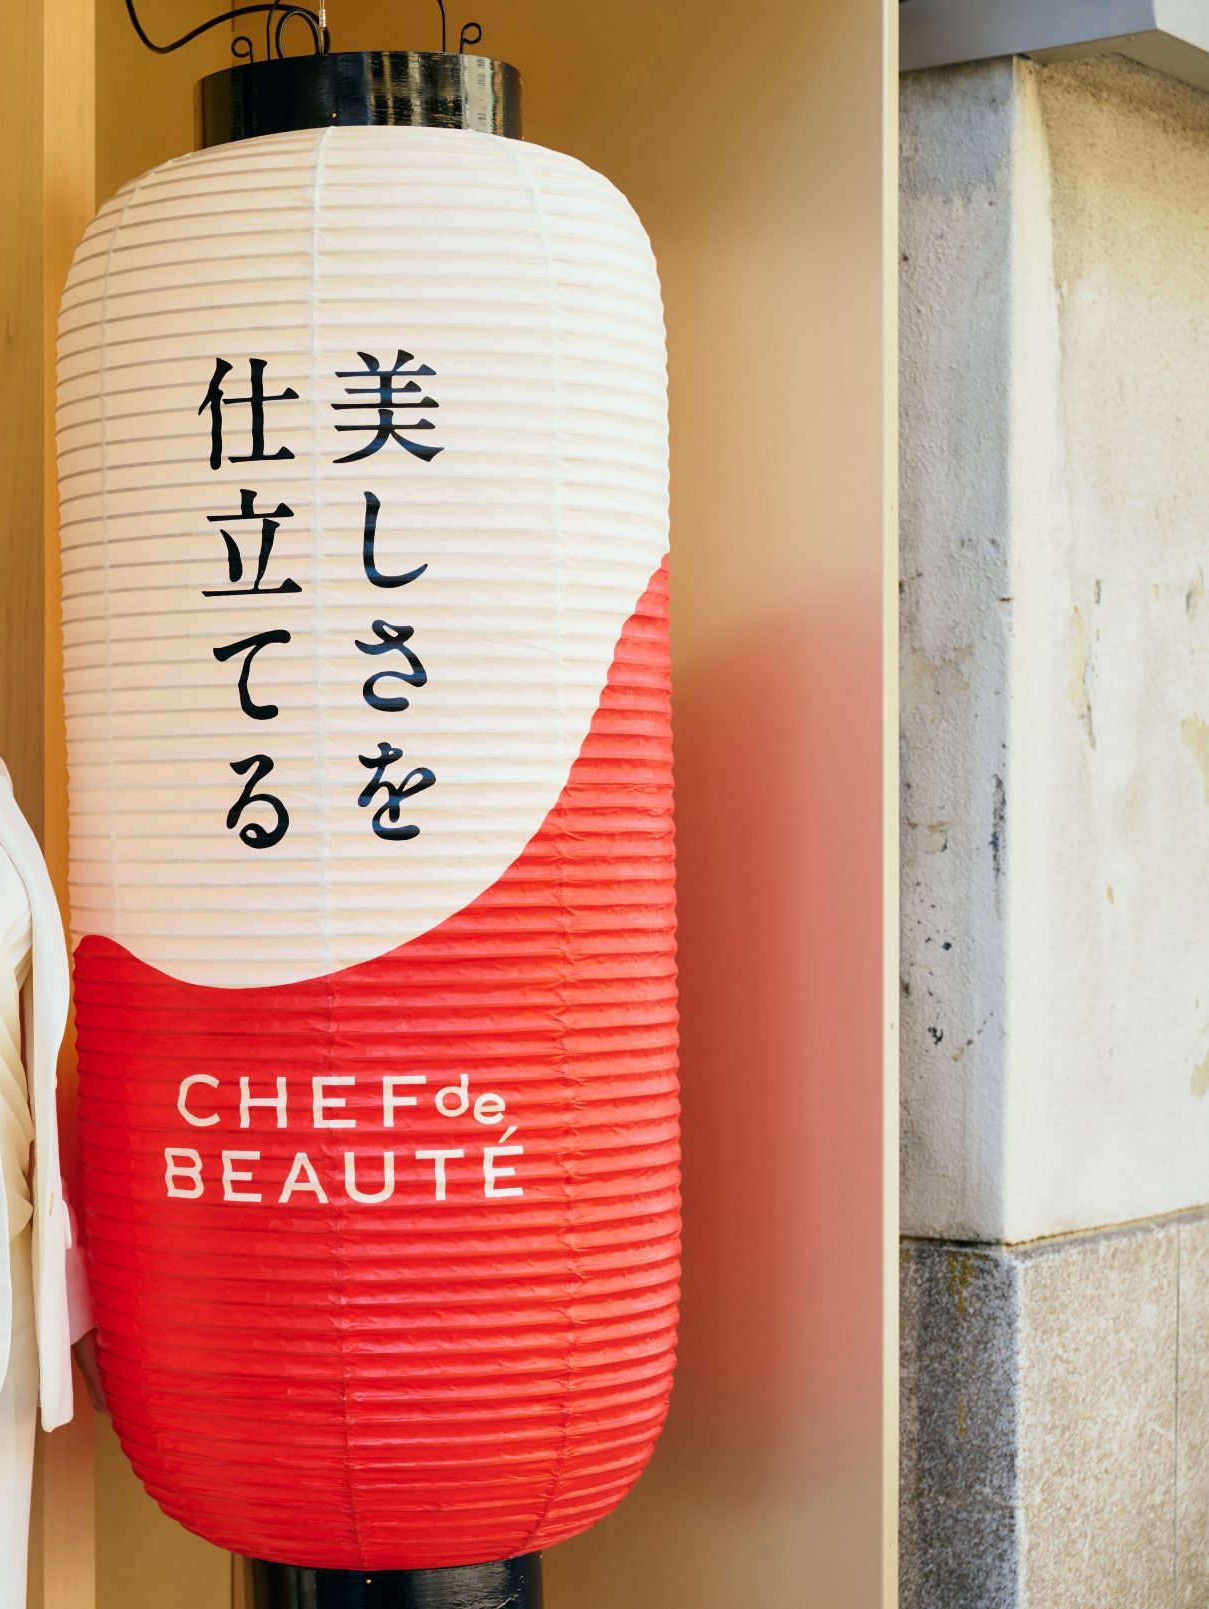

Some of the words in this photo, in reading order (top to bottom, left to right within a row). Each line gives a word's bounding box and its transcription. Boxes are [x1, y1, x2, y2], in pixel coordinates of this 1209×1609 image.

[197, 357, 303, 850] 仕立てる
[330, 349, 445, 841] 美しさを
[164, 1125, 525, 1204] BEAUTÉ
[177, 1073, 427, 1128] CHEF
[434, 1073, 507, 1125] de
